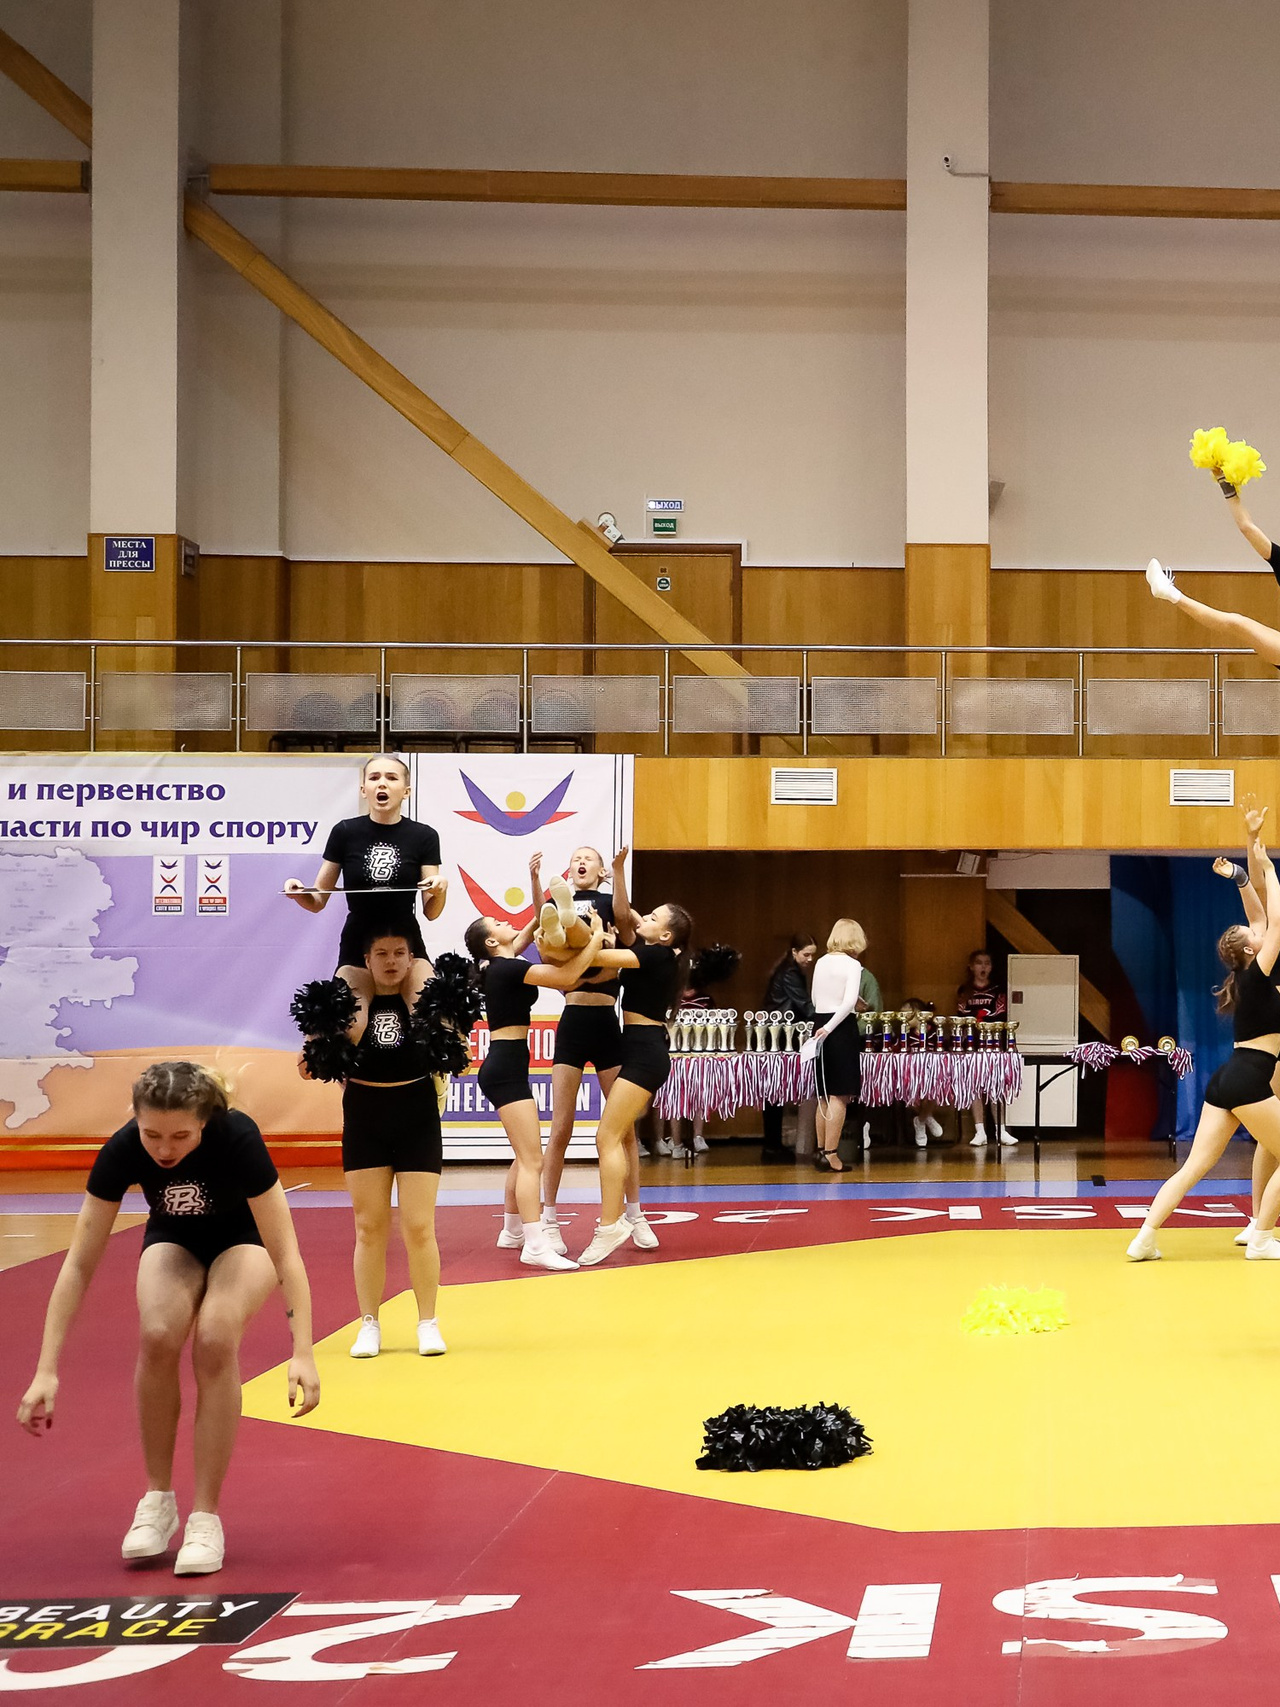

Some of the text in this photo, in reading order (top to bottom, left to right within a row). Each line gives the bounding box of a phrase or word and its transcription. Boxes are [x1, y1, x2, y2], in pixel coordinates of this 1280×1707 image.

[647, 500, 681, 510] ЫХОД
[112, 540, 147, 549] МЕСТА
[117, 550, 139, 559] ДЛЯ
[109, 560, 151, 568] ПРЕССЫ
[8, 783, 226, 807] и первенство
[91, 820, 131, 838] по
[141, 820, 200, 845] чир
[209, 820, 318, 845] спорту
